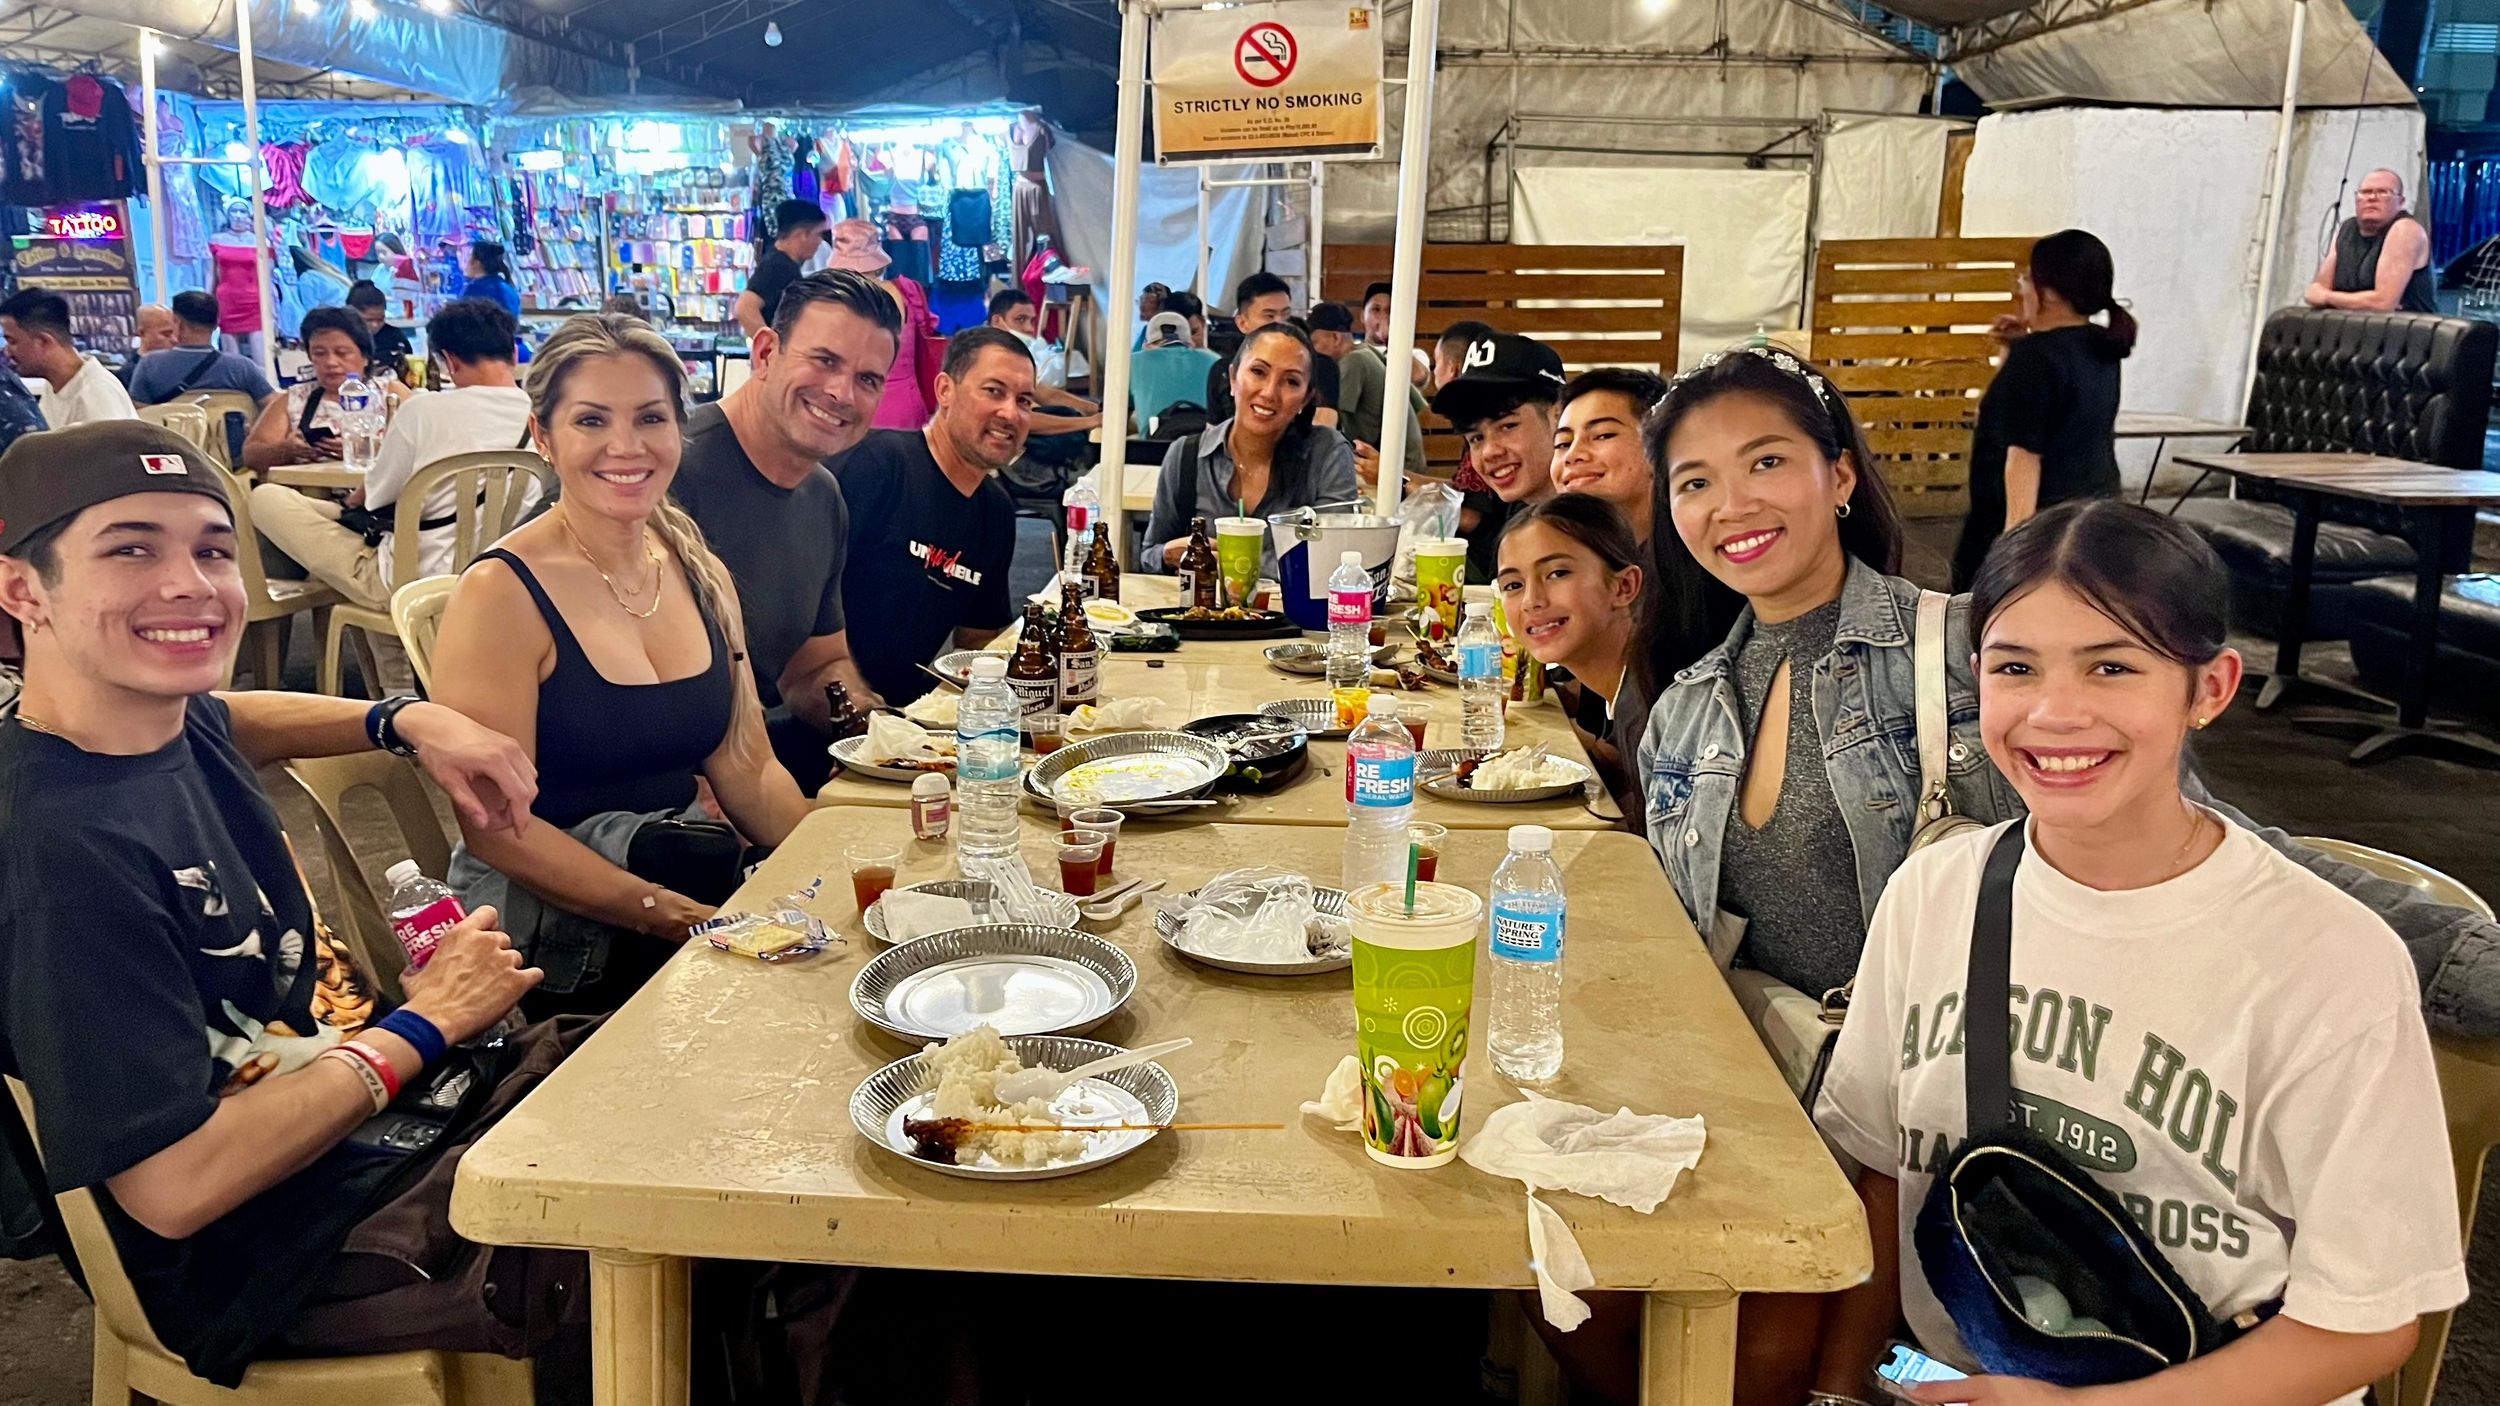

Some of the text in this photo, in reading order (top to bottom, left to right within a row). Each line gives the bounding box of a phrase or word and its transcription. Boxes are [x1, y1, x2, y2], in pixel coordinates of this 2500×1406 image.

[1174, 92, 1362, 114] STRICTLY NO SMOKING
[49, 215, 117, 237] TATTOO
[1329, 603, 1361, 615] FRESH
[1356, 763, 1380, 779] RE
[1356, 776, 1410, 794] FRESH
[397, 922, 418, 943] RE
[1497, 917, 1546, 931] NATURE'S
[1500, 926, 1539, 939] SPRING
[404, 917, 456, 957] FRESH
[2054, 1116, 2118, 1163] 1912
